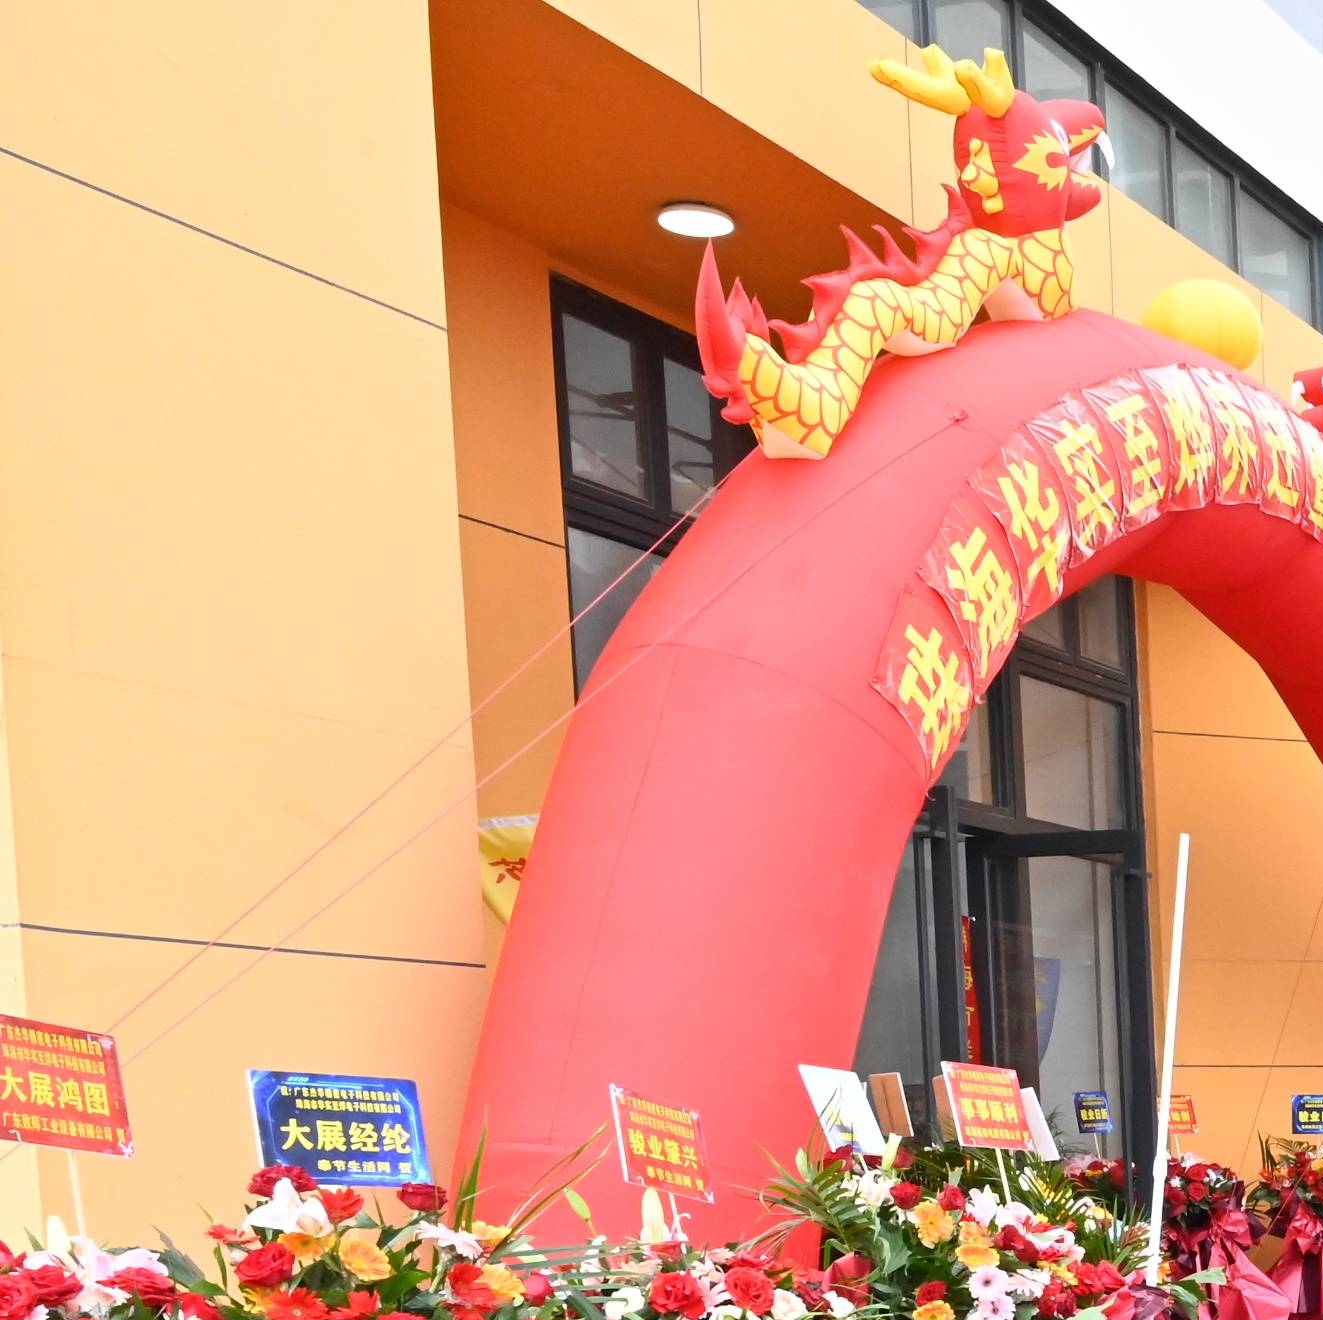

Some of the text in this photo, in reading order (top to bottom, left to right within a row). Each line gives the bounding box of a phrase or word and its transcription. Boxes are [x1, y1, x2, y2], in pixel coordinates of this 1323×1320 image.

[0, 1067, 110, 1116] 大展鸿图
[960, 1097, 1019, 1124] 事事顺利
[280, 1118, 412, 1154] 大展经纶
[627, 1127, 698, 1170] 骏业肇兴
